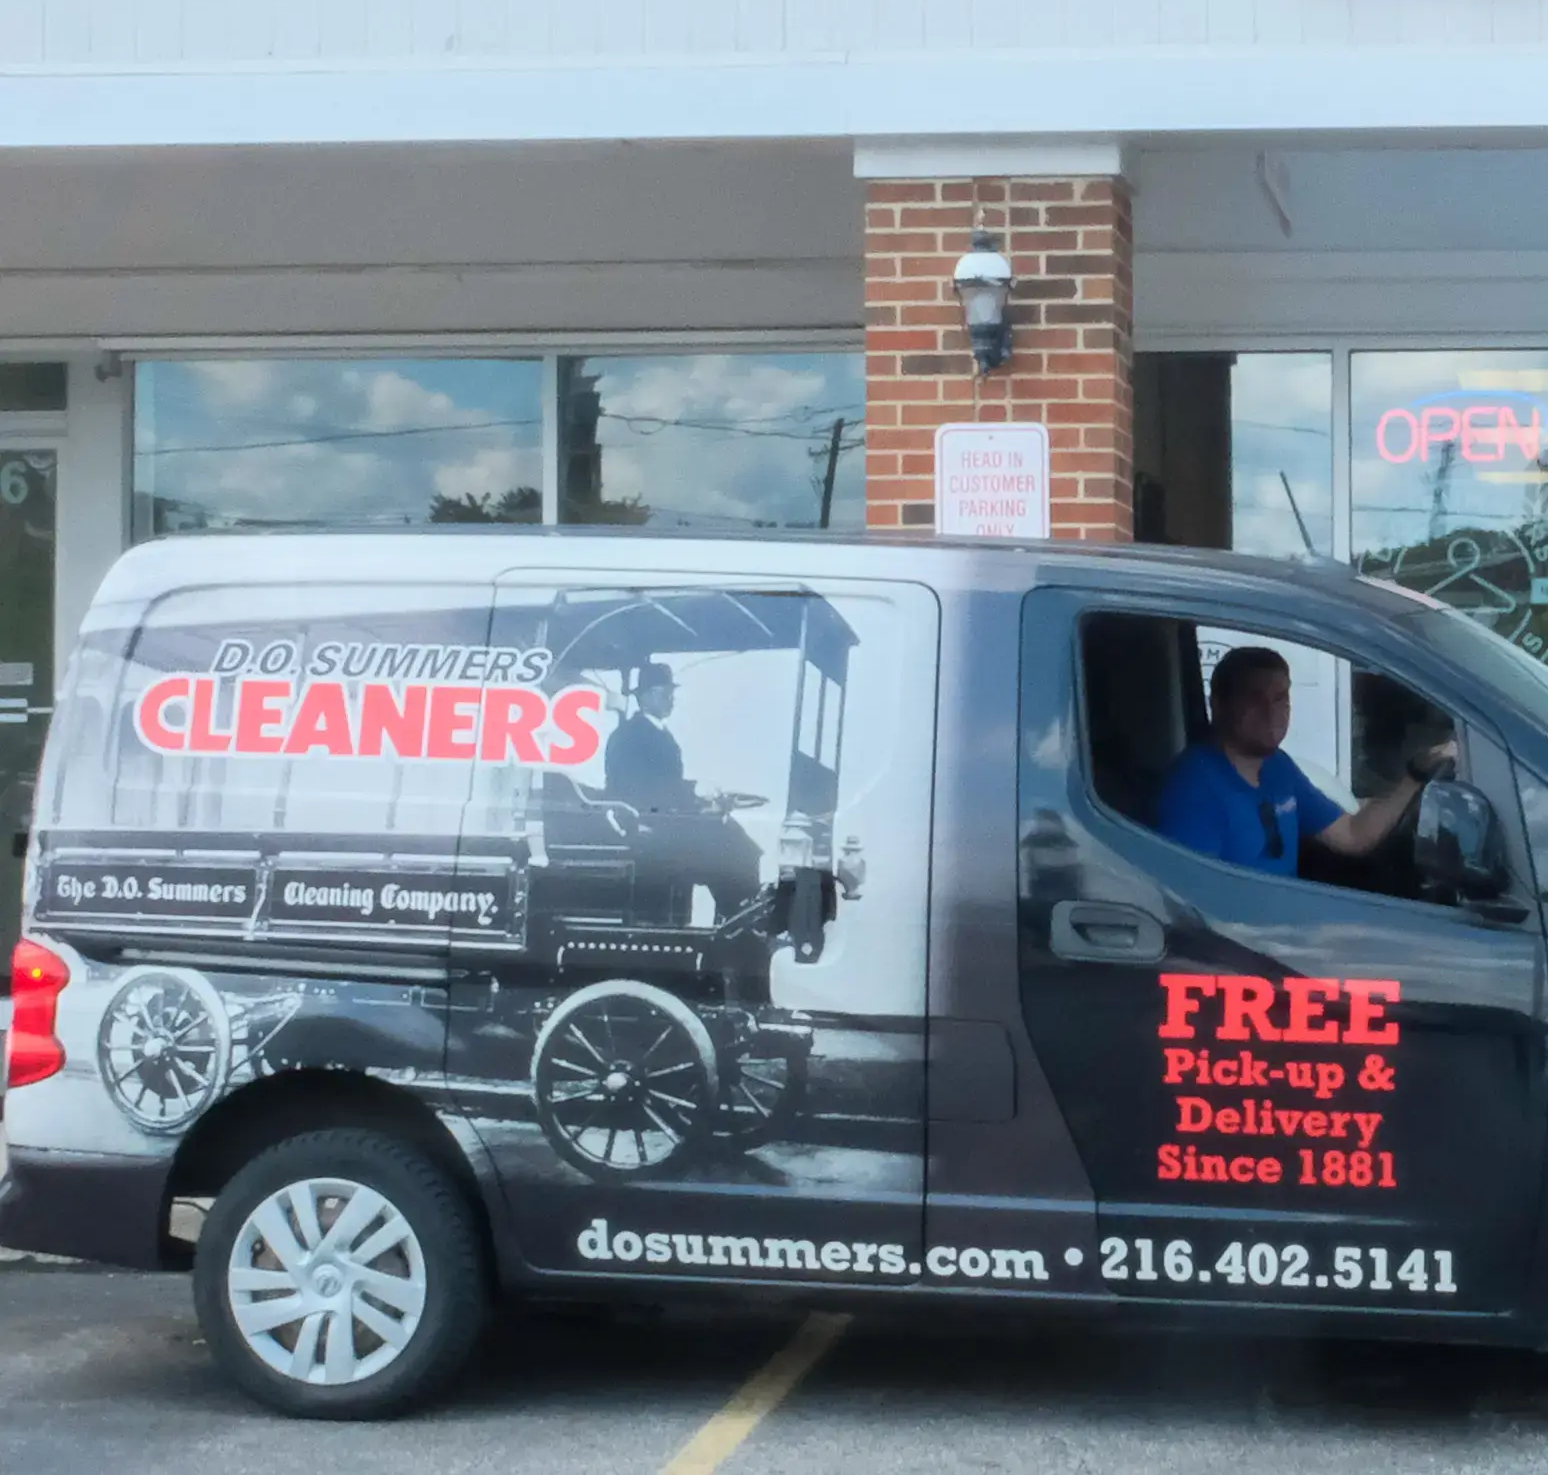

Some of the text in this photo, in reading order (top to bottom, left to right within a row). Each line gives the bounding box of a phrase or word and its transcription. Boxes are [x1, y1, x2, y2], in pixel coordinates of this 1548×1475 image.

[1376, 406, 1540, 464] OPEN
[961, 451, 1024, 469] HEAD IN
[949, 473, 1036, 493] CUSTOMER
[959, 499, 1027, 517] PARKING
[214, 641, 552, 683] D.O. SUMMERS
[139, 677, 601, 765] CLEANERS
[57, 875, 247, 905] The D.O. Summers
[284, 881, 499, 925] Cleaning Company.
[1158, 973, 1400, 1045] FREE
[1163, 1048, 1396, 1099] Pick-up &
[1175, 1096, 1383, 1148] Delivery
[1157, 1143, 1397, 1187] Since 1881
[577, 1218, 1458, 1293] dosummers.com 216.402.5141
